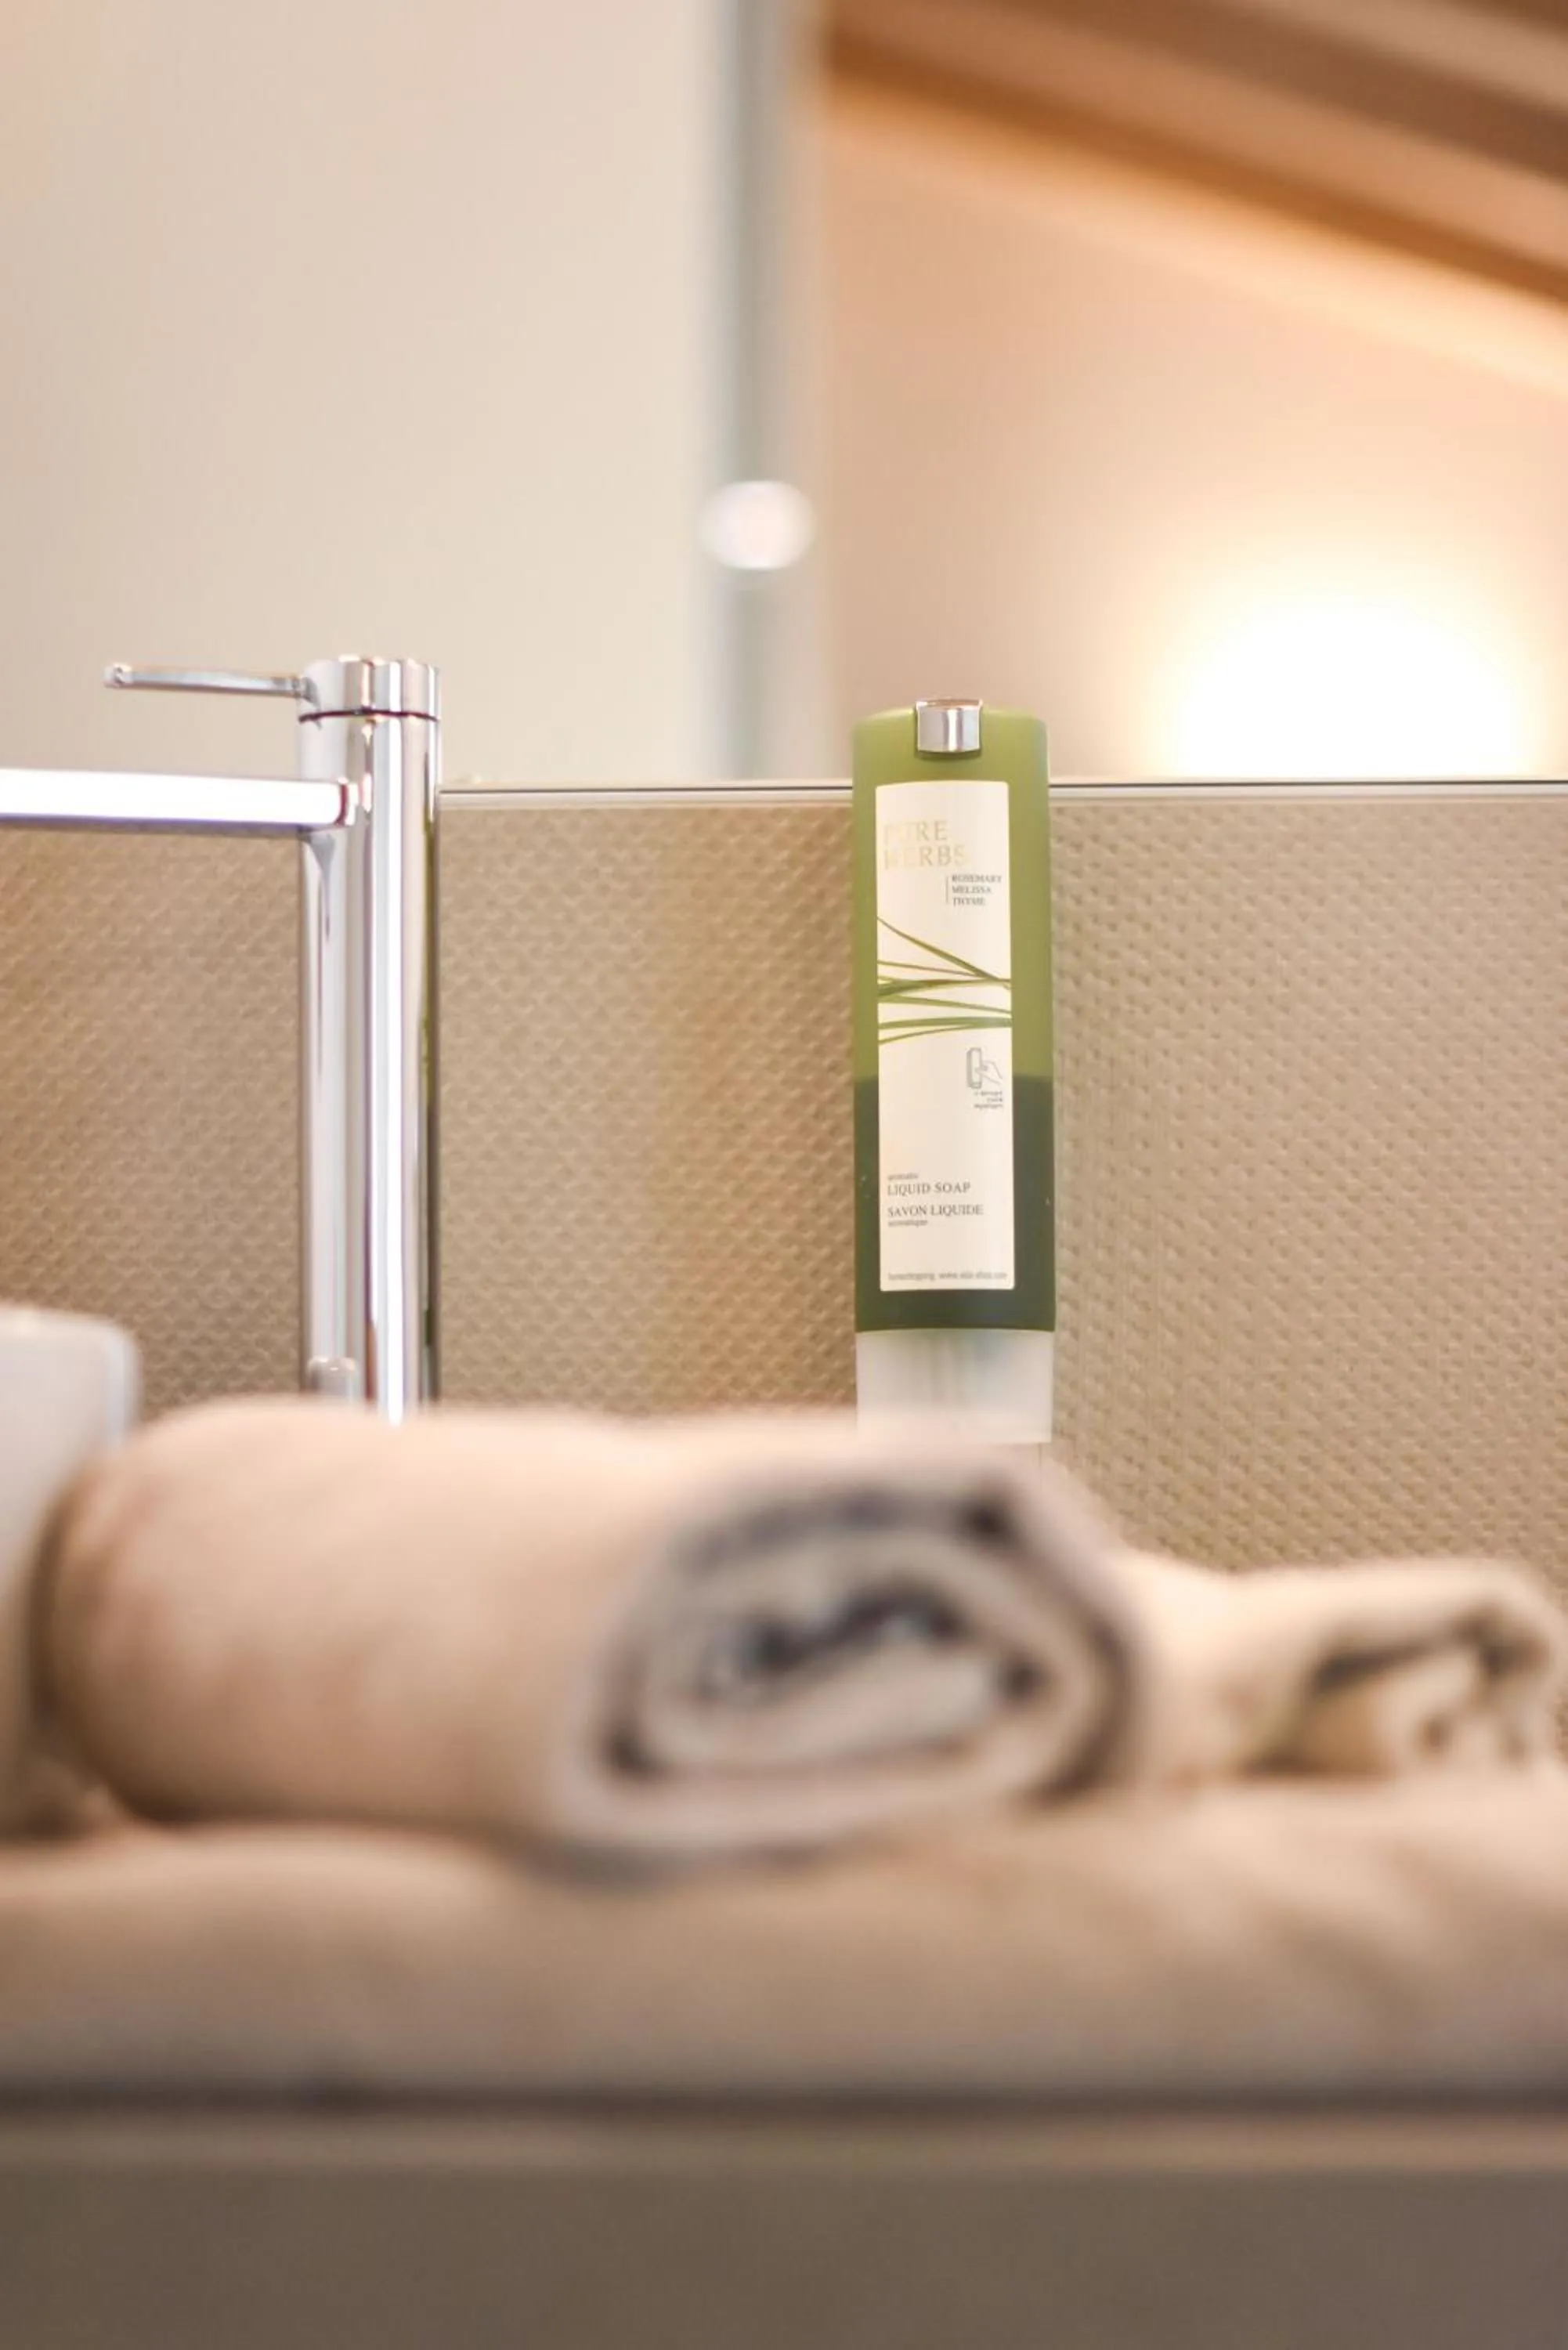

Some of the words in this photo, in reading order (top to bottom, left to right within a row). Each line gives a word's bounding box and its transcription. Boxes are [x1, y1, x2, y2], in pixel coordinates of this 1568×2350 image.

[952, 873, 1002, 883] ROSEMARY
[952, 885, 992, 894] MELISSA
[953, 897, 985, 906] THYME
[887, 1184, 930, 1197] LIQUID
[933, 1181, 970, 1193] SOAP
[887, 1206, 928, 1217] SAVON
[930, 1204, 984, 1217] LIQUIDE
